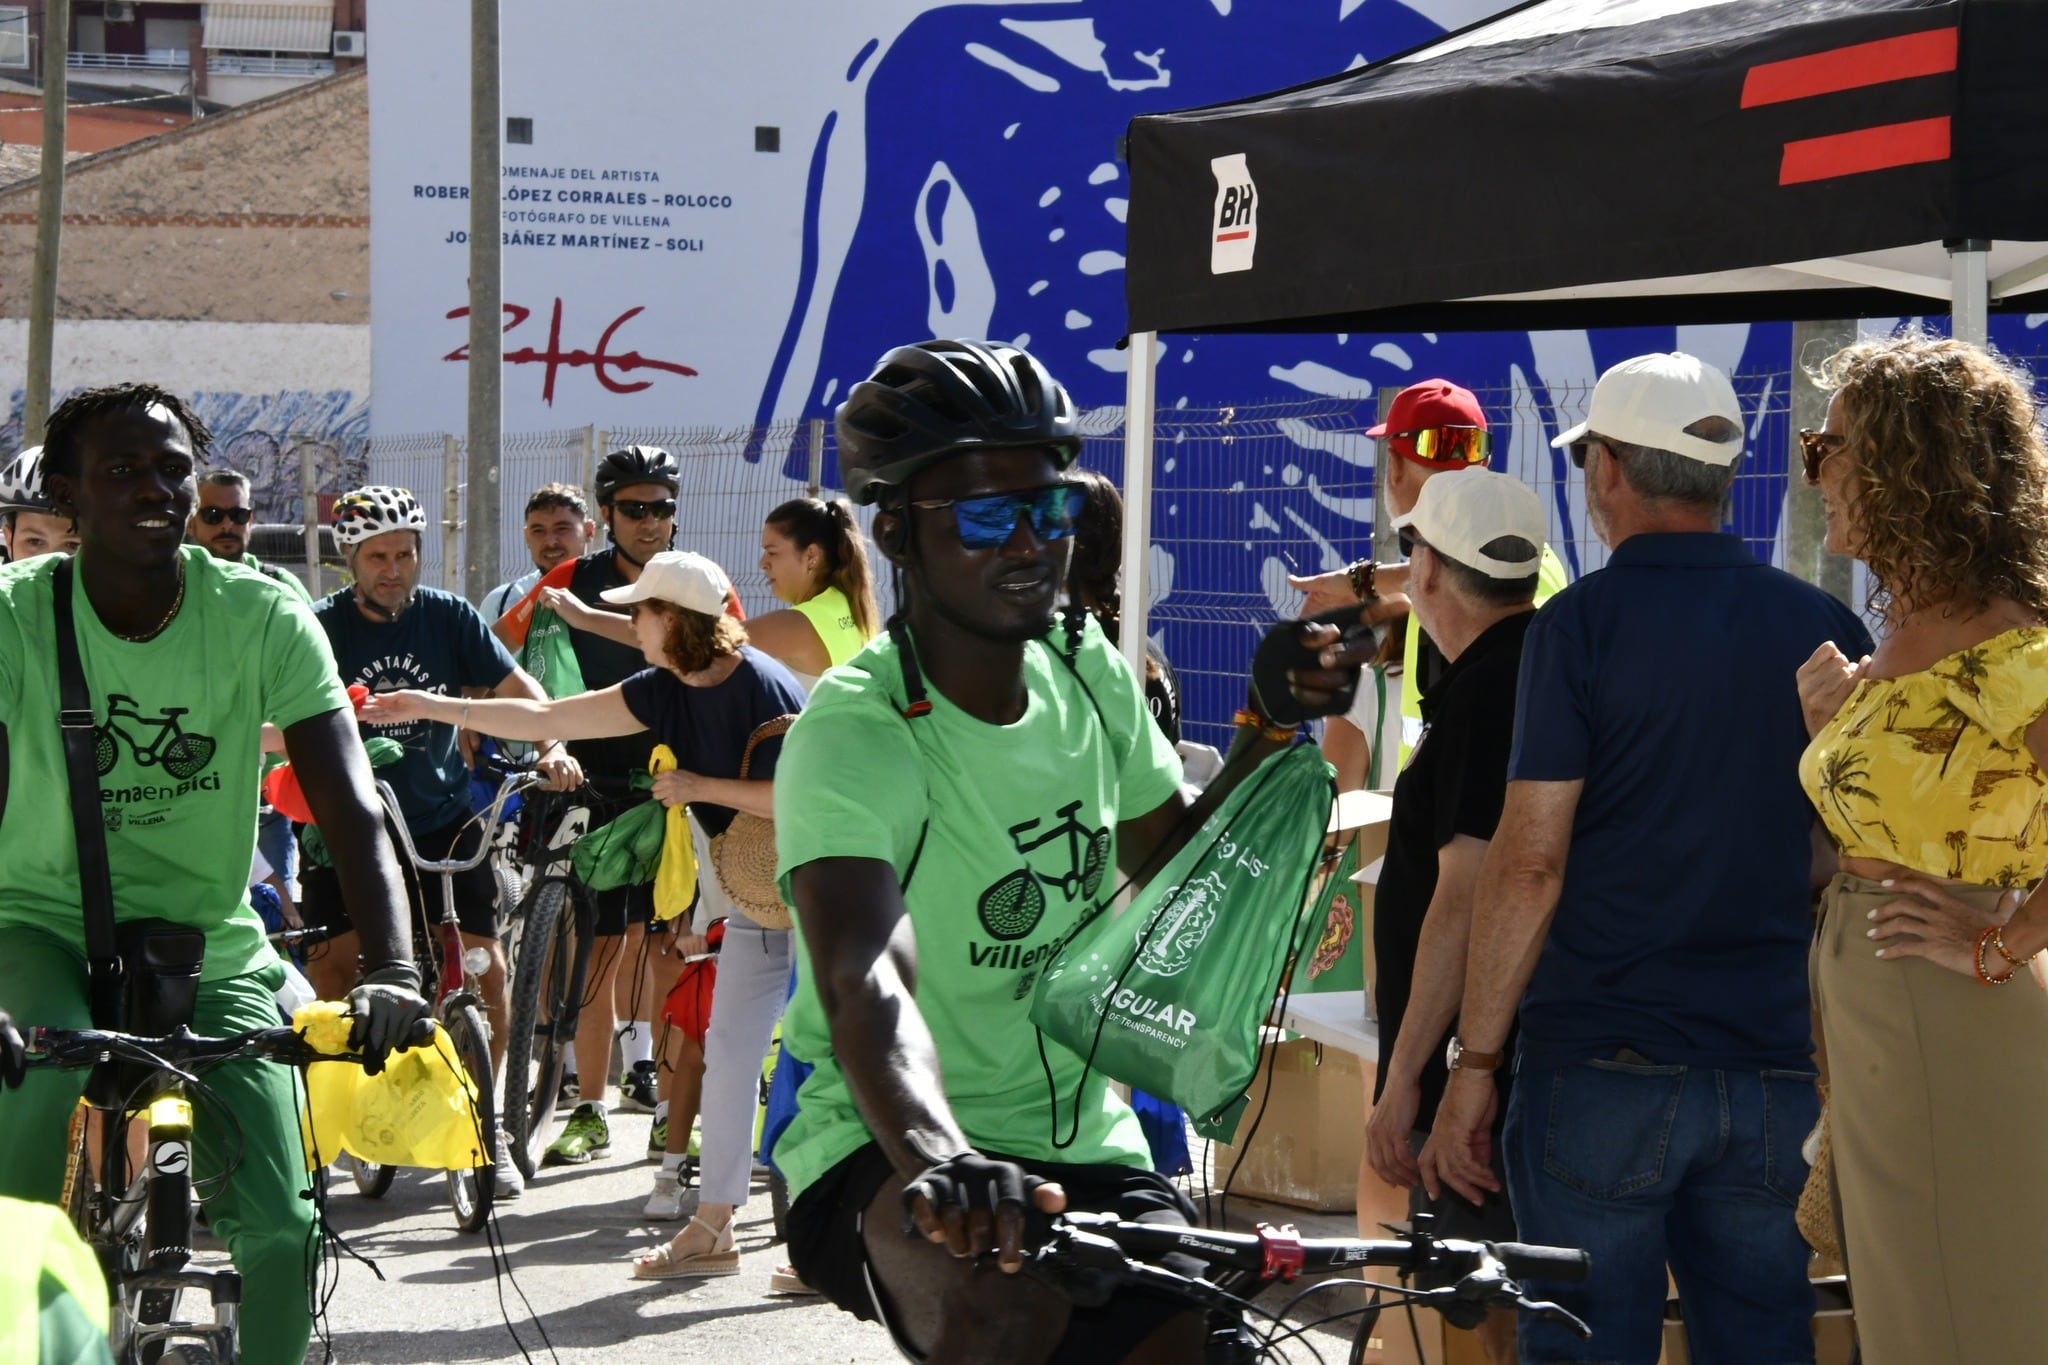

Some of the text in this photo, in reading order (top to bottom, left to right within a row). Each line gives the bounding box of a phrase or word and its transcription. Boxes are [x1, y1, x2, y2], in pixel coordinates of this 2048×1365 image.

[571, 169, 596, 180] DEL
[601, 170, 660, 182] ARTISTA
[413, 185, 470, 199] ROBER
[557, 190, 647, 205] CORRALES
[664, 194, 732, 208] ROLOCO
[1219, 184, 1253, 228] BH
[590, 214, 607, 225] DE
[612, 215, 671, 227] VILLENA
[562, 233, 650, 249] MARTÍNEZ
[666, 238, 703, 251] SOLI
[353, 653, 430, 686] MONTAÑAS
[1121, 1016, 1187, 1049] TRANSPARENCY
